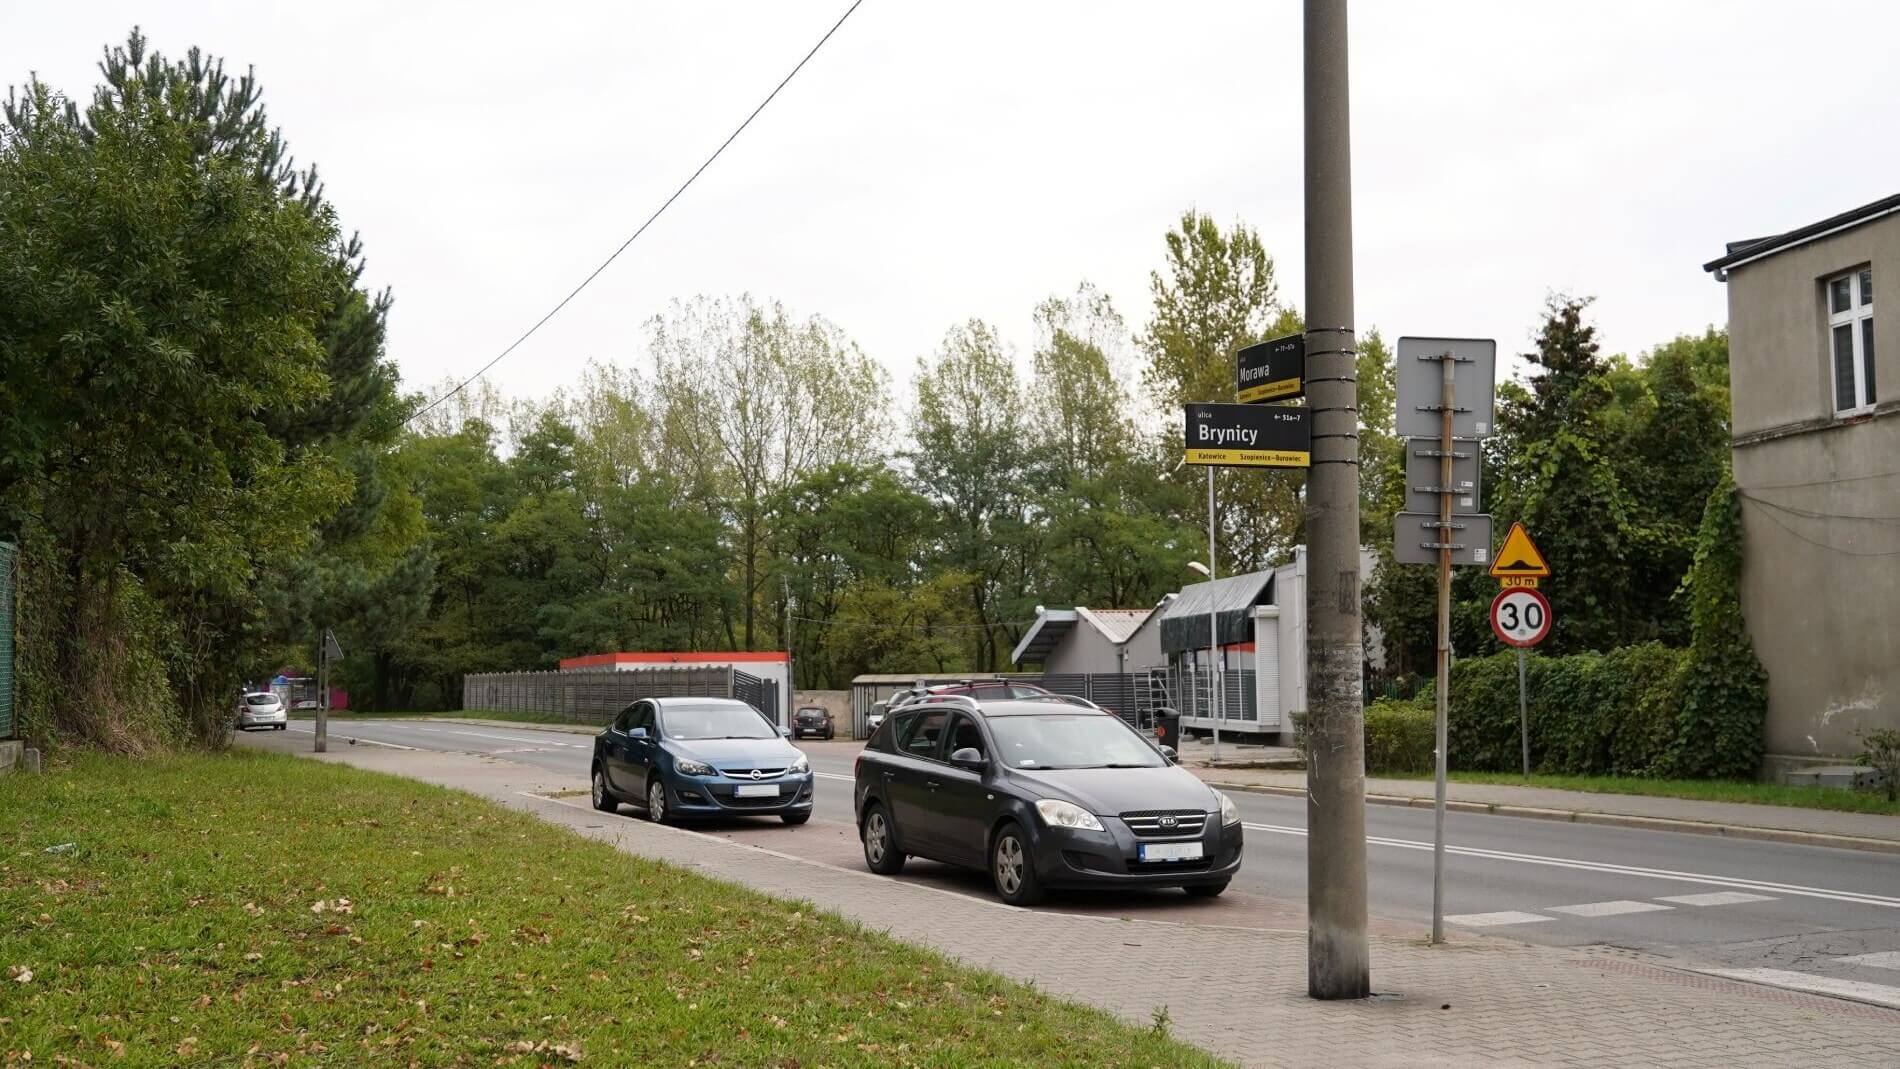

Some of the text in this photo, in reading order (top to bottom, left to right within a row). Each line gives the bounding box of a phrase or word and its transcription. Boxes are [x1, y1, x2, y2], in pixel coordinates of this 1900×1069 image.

[1240, 364, 1270, 382] Morawa
[1198, 411, 1212, 419] ulica
[1199, 424, 1258, 445] Brynicy
[1506, 577, 1535, 586] 30 m
[1501, 602, 1543, 631] 30
